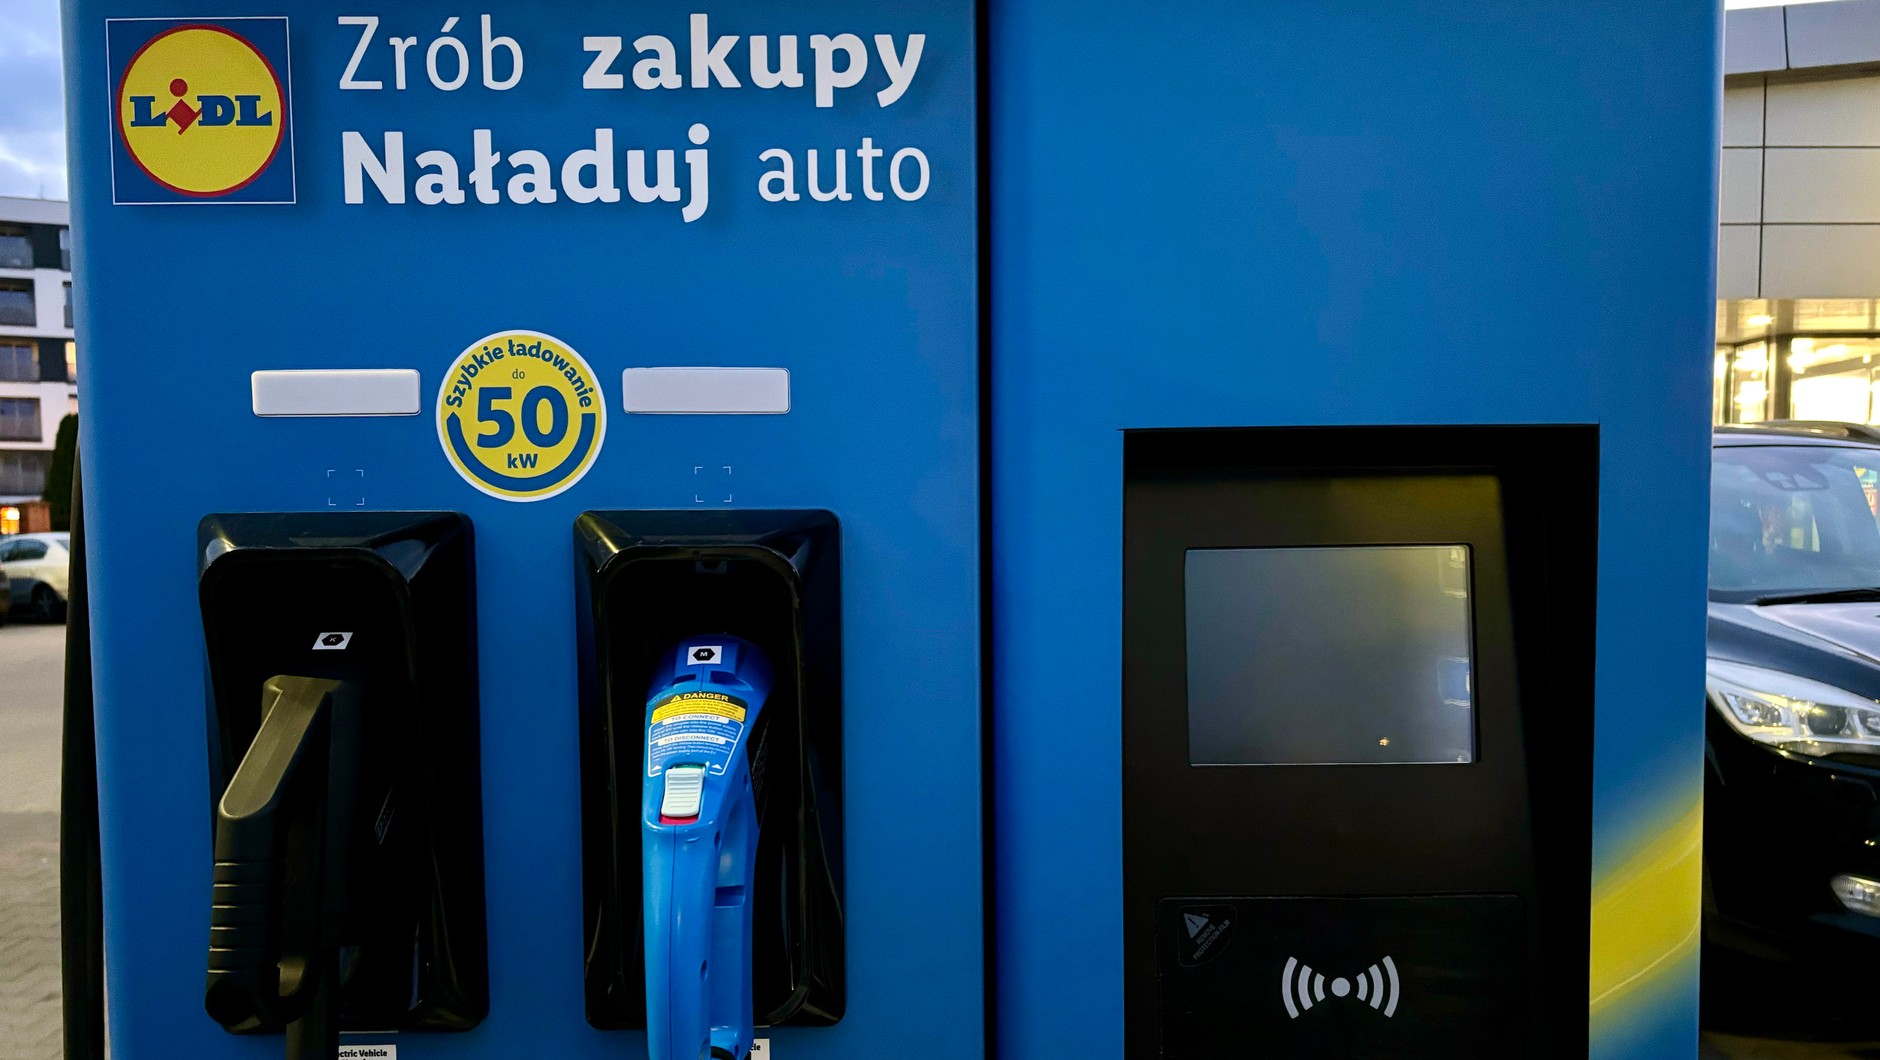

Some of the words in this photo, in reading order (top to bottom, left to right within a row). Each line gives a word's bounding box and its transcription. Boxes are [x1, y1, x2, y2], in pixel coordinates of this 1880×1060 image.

[338, 14, 524, 92] Zrób
[582, 13, 926, 108] zakupy
[342, 123, 710, 223] Naładuj
[758, 138, 930, 203] auto
[445, 345, 505, 408] Szybkie
[508, 339, 594, 408] ładowanie
[511, 368, 525, 380] do
[477, 385, 569, 448] 50
[507, 453, 538, 469] kW
[683, 692, 729, 702] DANGER
[674, 735, 720, 743] DISCONNECT
[339, 1049, 358, 1058] ctric
[359, 1048, 388, 1058] Vehicle
